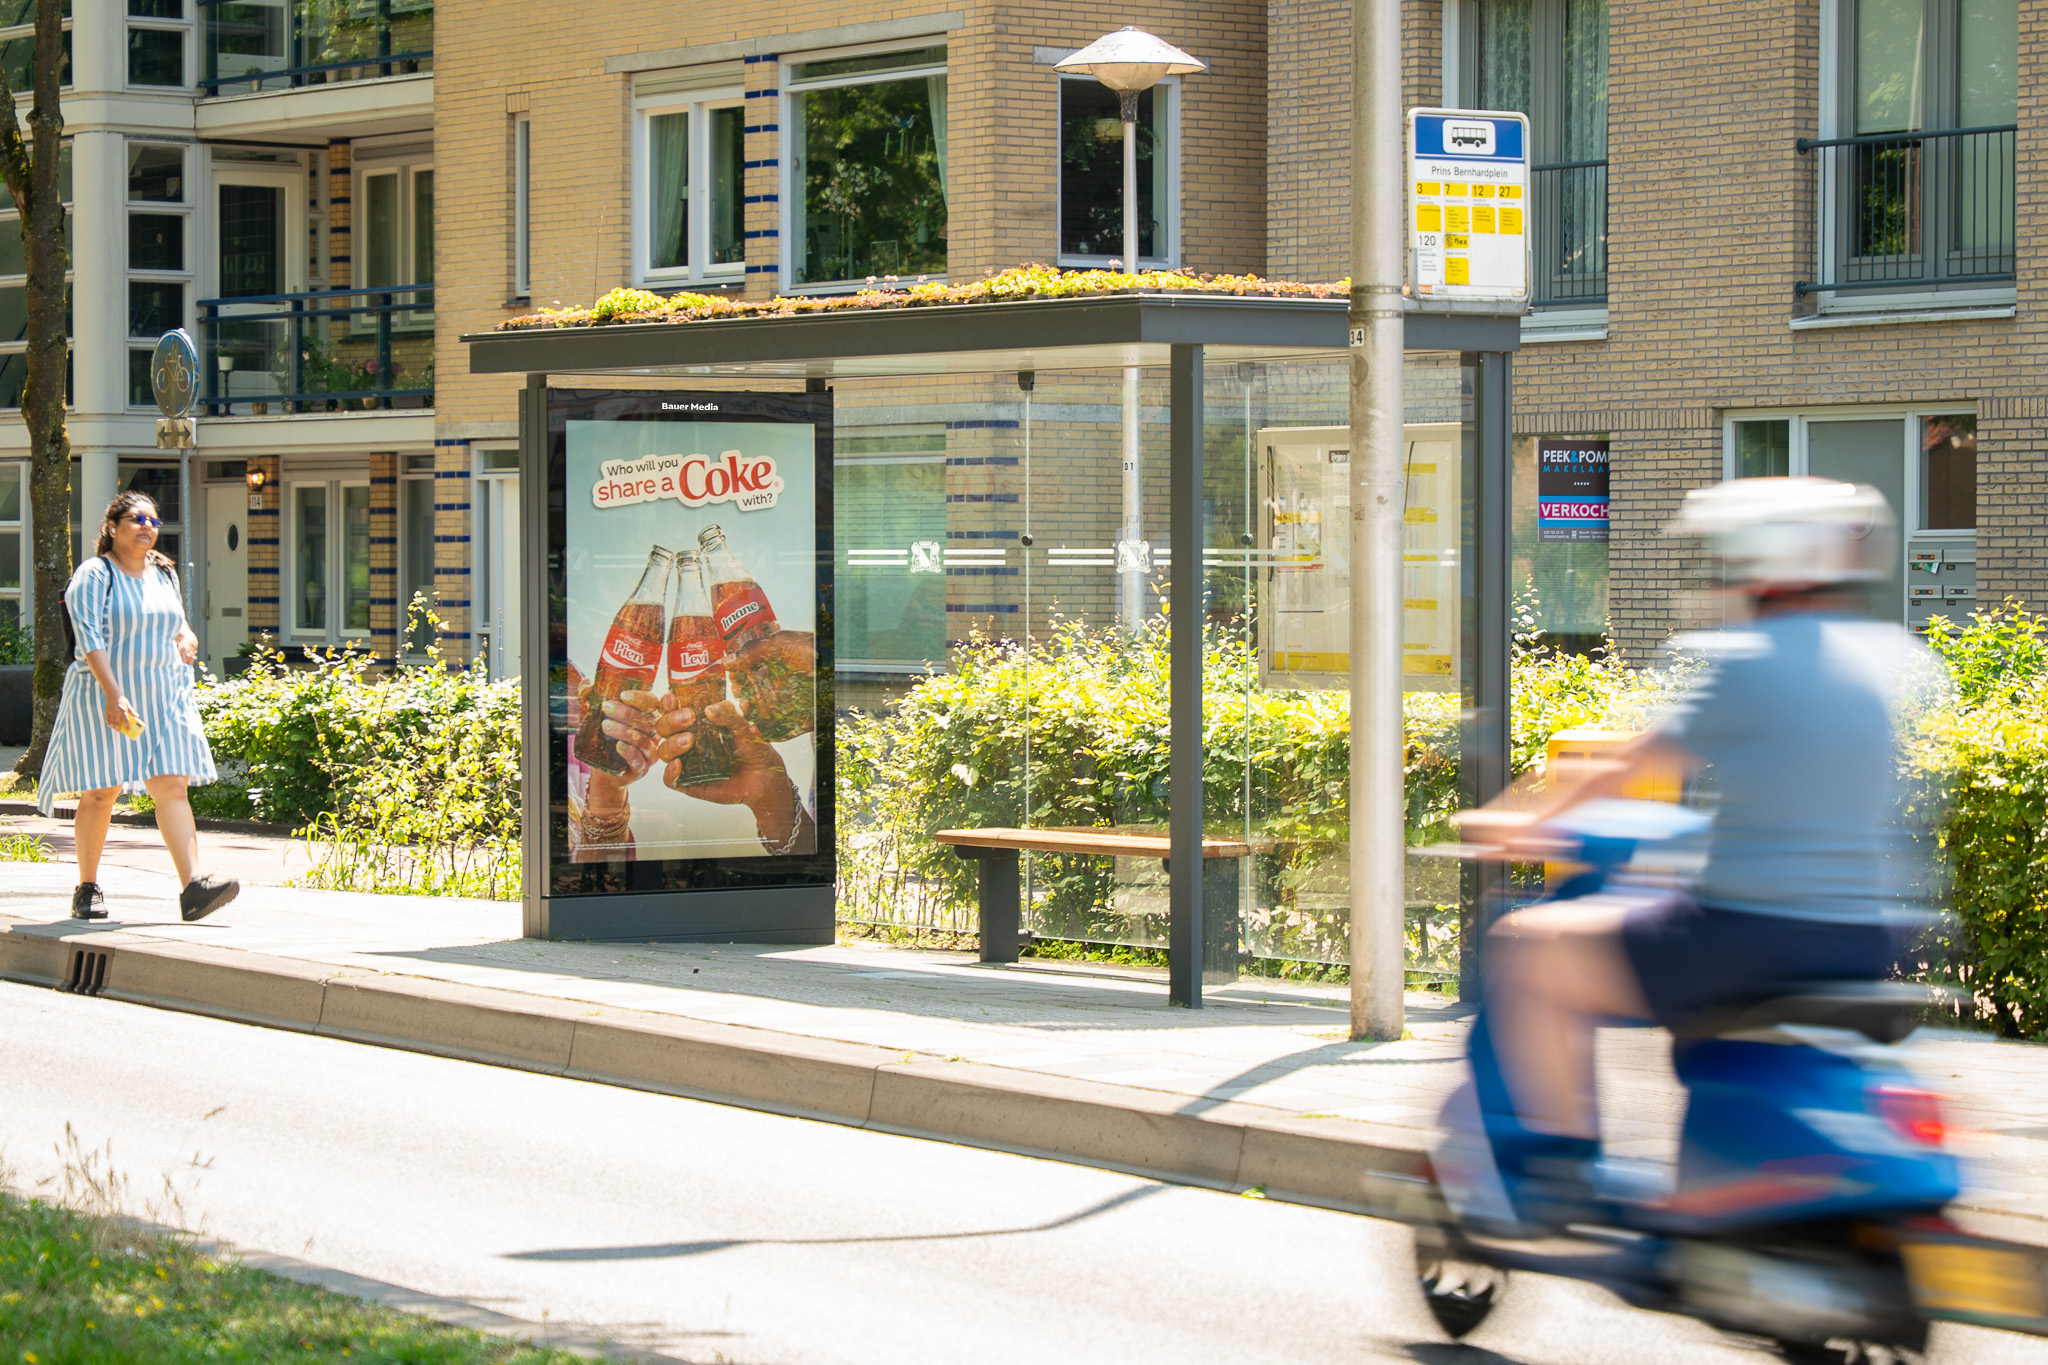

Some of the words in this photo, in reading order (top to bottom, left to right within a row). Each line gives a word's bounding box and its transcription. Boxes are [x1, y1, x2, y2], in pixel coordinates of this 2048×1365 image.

[1431, 165, 1452, 176] Prins
[1454, 166, 1508, 178] Bernhardplein
[1417, 183, 1423, 194] 3
[1444, 184, 1451, 195] 7
[1473, 185, 1484, 196] 12
[1499, 186, 1511, 197] 27
[1418, 235, 1436, 246] 120
[661, 402, 689, 411] Bauer
[690, 402, 719, 411] Media
[1543, 450, 1610, 463] PEEK&POM
[606, 464, 634, 477] Who
[635, 460, 656, 473] will
[658, 458, 679, 472] you
[1543, 465, 1610, 473] MAKELAA
[597, 479, 656, 501] share
[661, 476, 675, 492] a
[678, 455, 773, 501] Coke
[742, 492, 773, 507] with?
[1541, 503, 1610, 517] VERKOCH
[721, 602, 759, 631] Imane
[613, 640, 644, 665] Pien
[681, 650, 709, 667] Levi
